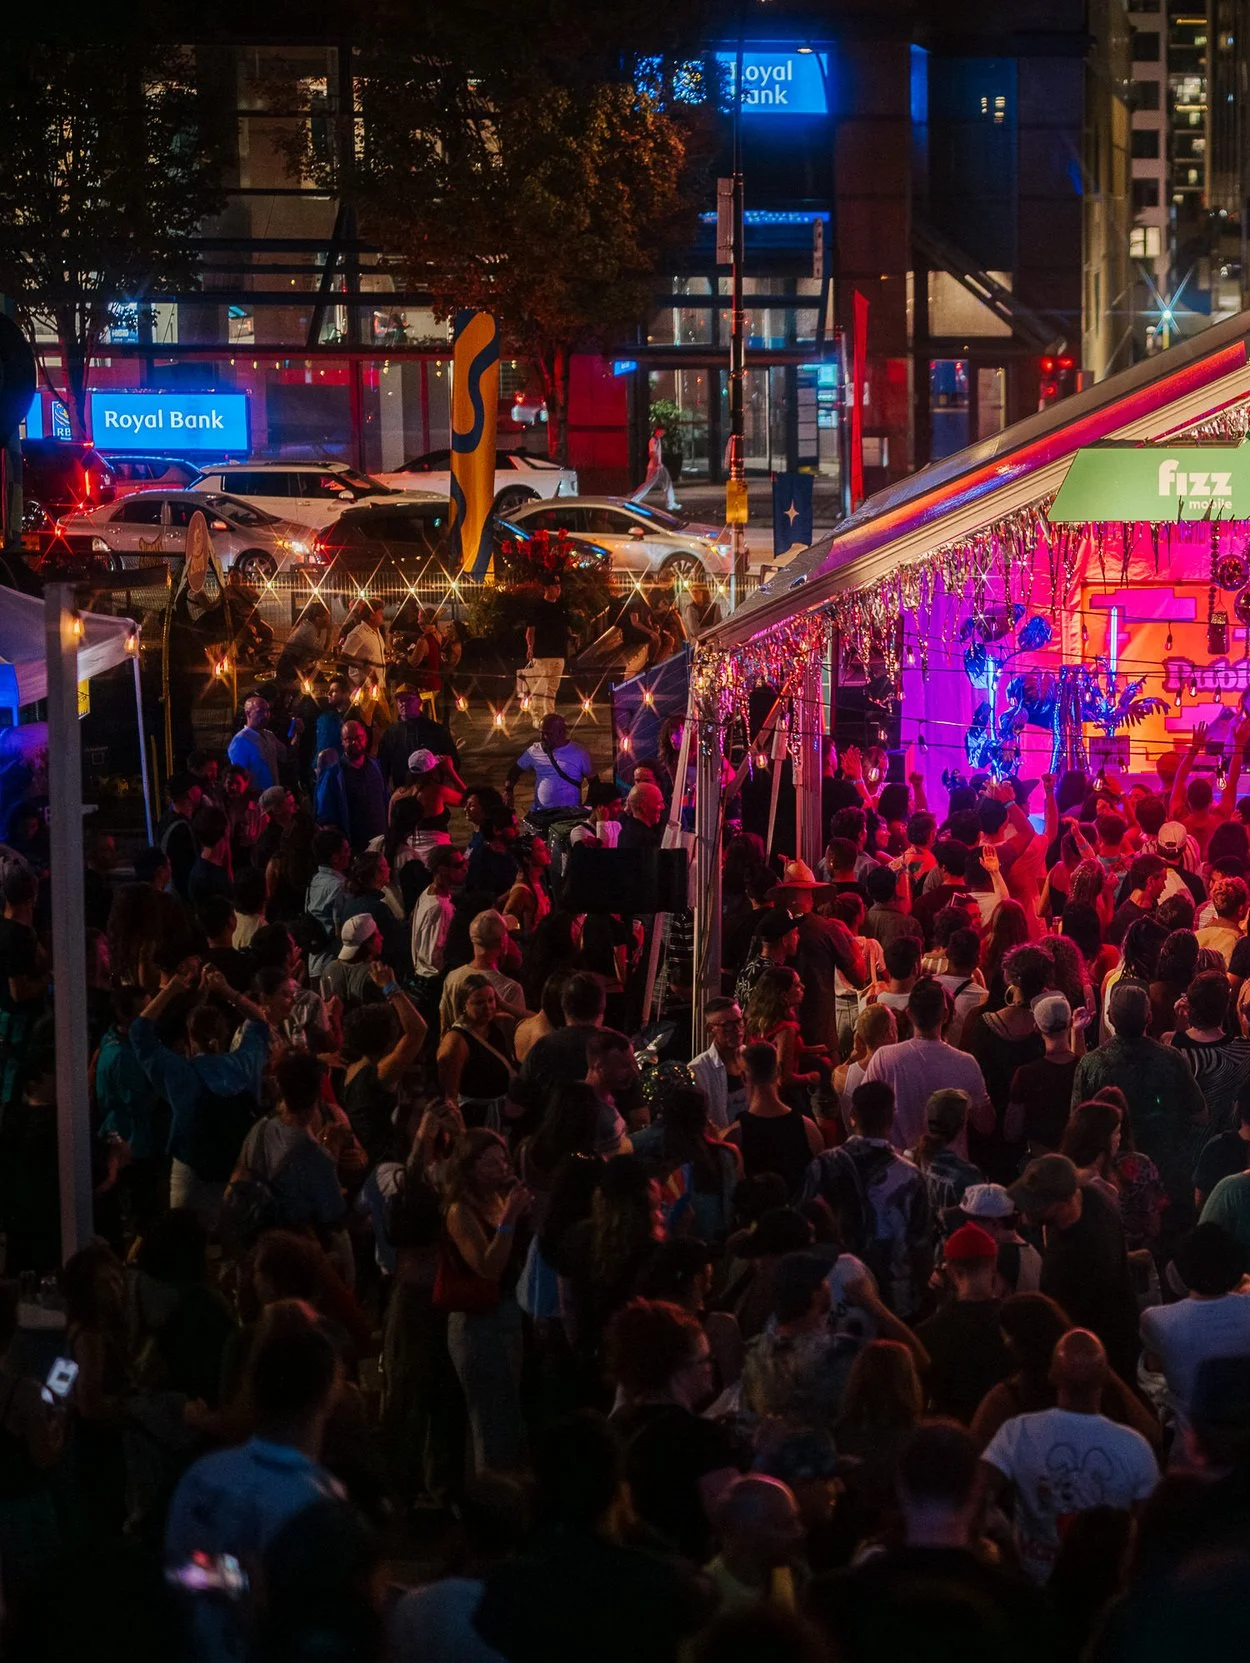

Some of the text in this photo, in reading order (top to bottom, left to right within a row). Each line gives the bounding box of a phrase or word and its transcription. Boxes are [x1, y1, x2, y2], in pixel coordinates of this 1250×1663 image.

[732, 84, 789, 104] ank
[104, 409, 225, 434] Royal Bank
[1158, 459, 1233, 496] fizz
[1188, 498, 1233, 510] mobile
